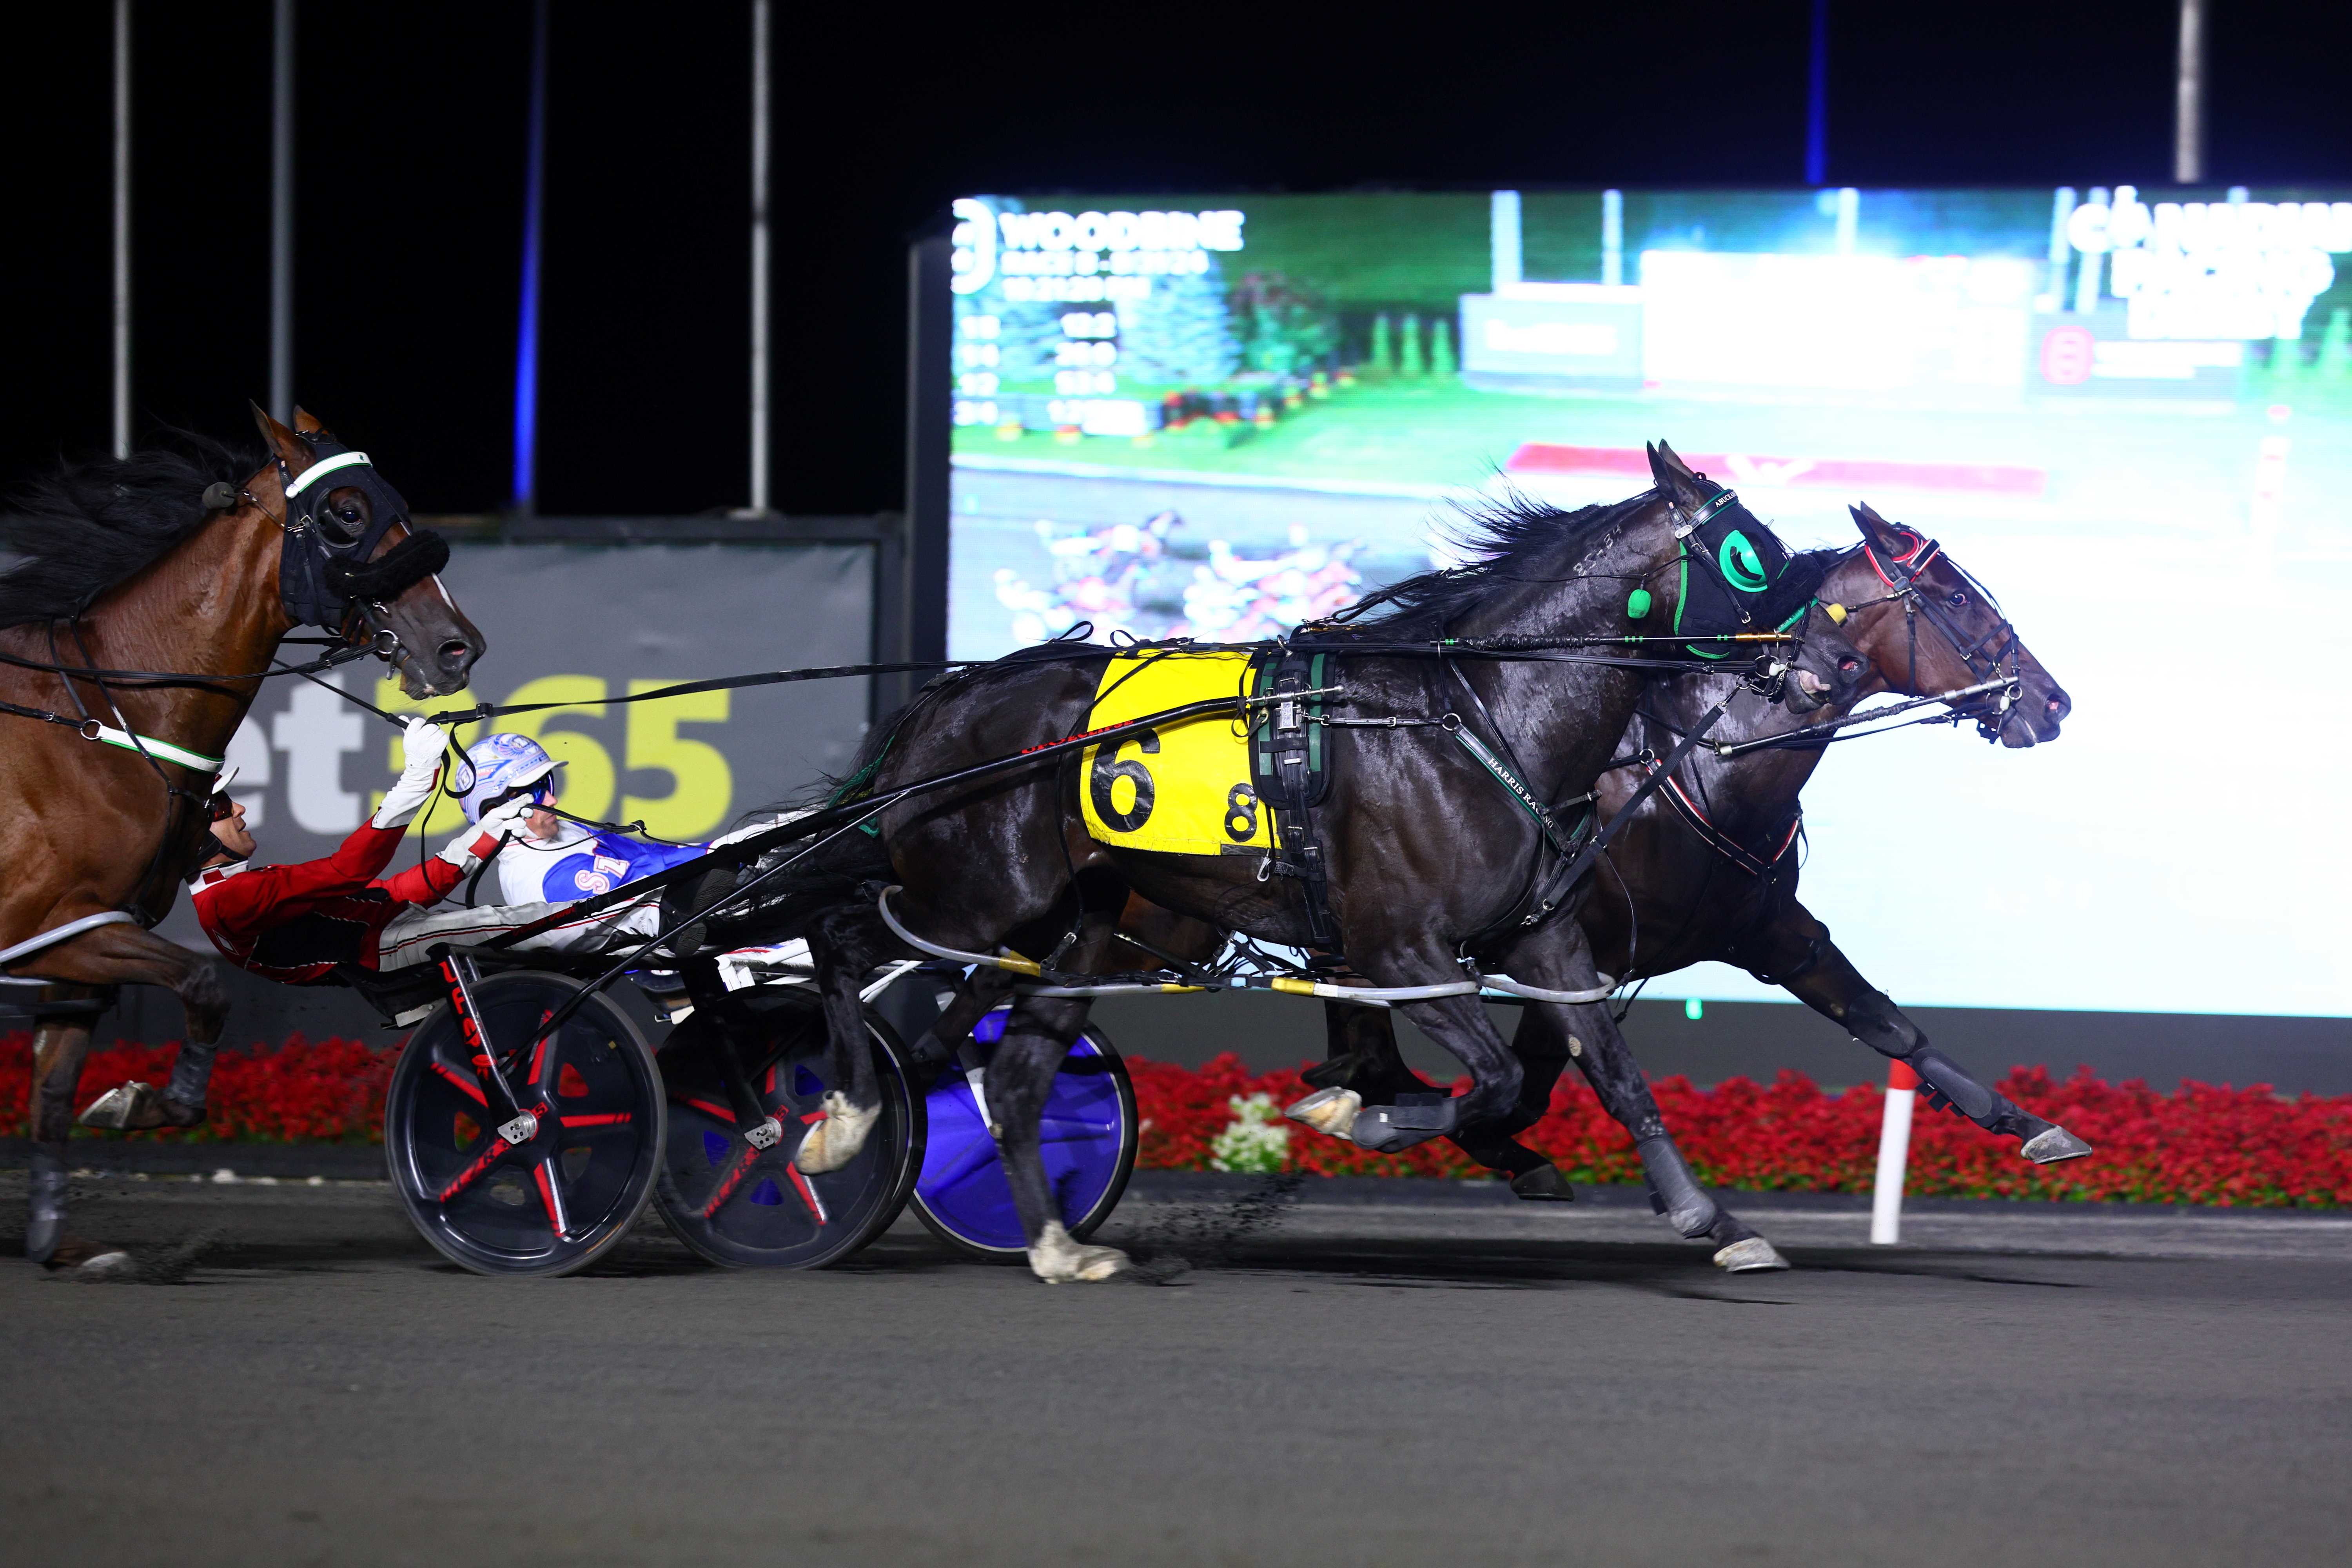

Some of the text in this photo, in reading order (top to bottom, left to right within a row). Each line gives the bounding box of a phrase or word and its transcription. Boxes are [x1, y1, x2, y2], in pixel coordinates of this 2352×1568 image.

[221, 671, 733, 839] et365
[1090, 728, 1160, 832] 6
[1488, 757, 1554, 829] HARRIS RANG
[1224, 782, 1258, 842] 8
